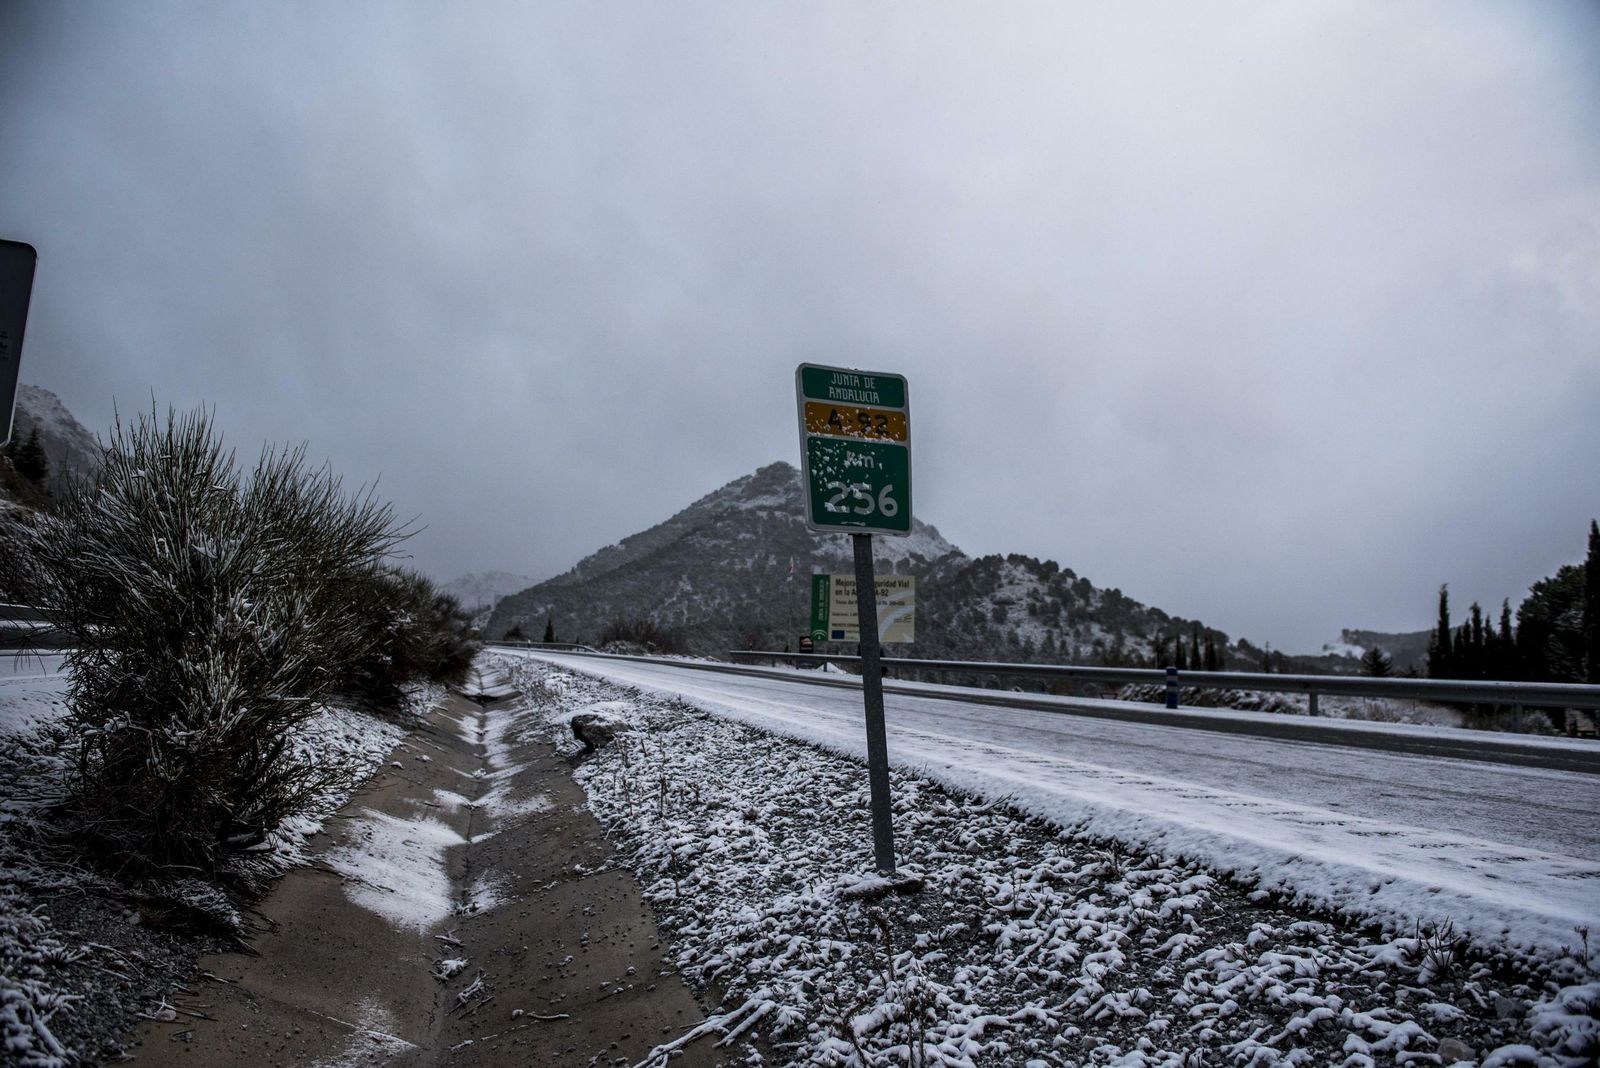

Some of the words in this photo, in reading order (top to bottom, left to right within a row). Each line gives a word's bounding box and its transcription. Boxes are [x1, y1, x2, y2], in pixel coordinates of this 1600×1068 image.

[831, 372, 860, 388] JUNTA
[864, 376, 876, 390] DE
[828, 408, 890, 435] A-92
[824, 481, 898, 517] 256
[835, 578, 856, 588] Mejora
[897, 579, 910, 588] Vial
[844, 588, 850, 596] la
[875, 588, 889, 597] A-92
